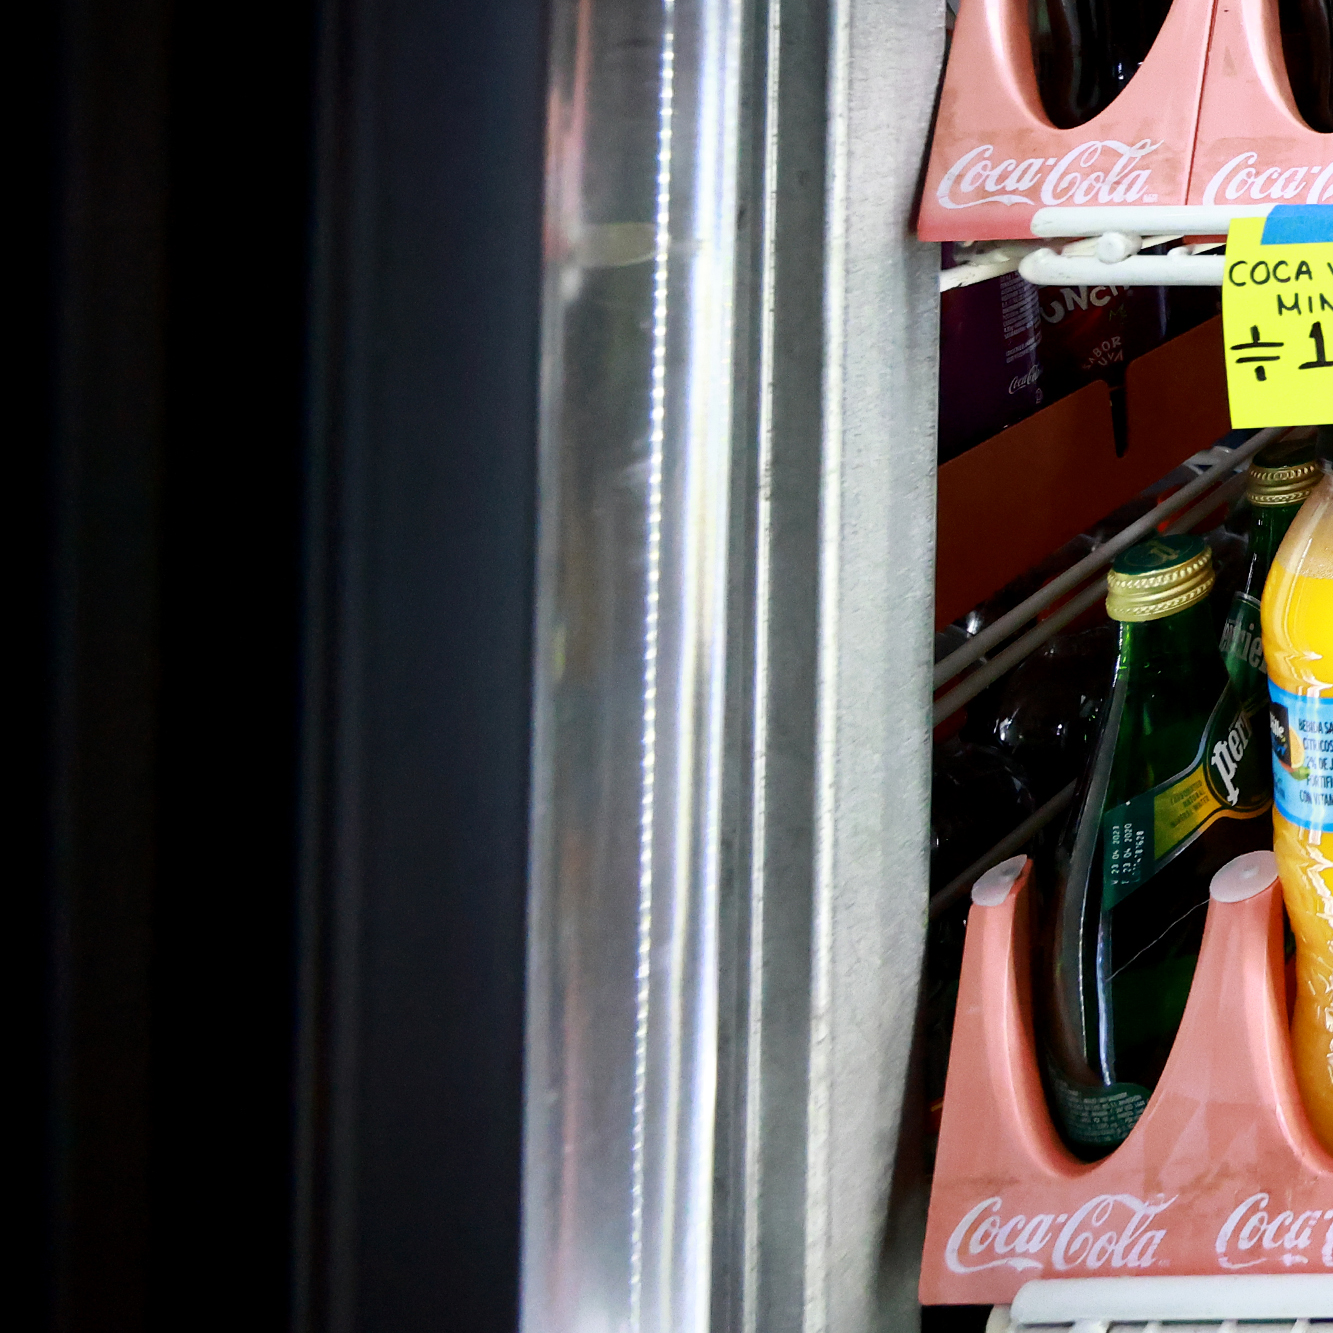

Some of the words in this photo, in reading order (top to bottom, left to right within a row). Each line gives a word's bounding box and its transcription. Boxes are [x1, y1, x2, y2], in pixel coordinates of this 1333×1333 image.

[937, 138, 1165, 209] Coca-Cola
[1229, 260, 1313, 287] COCA
[1098, 349, 1125, 368] UVA
[1298, 721, 1323, 733] BEBIDA
[1318, 758, 1328, 769] DE
[1299, 792, 1312, 804] CON
[945, 1192, 1179, 1274] Coca-Cola
